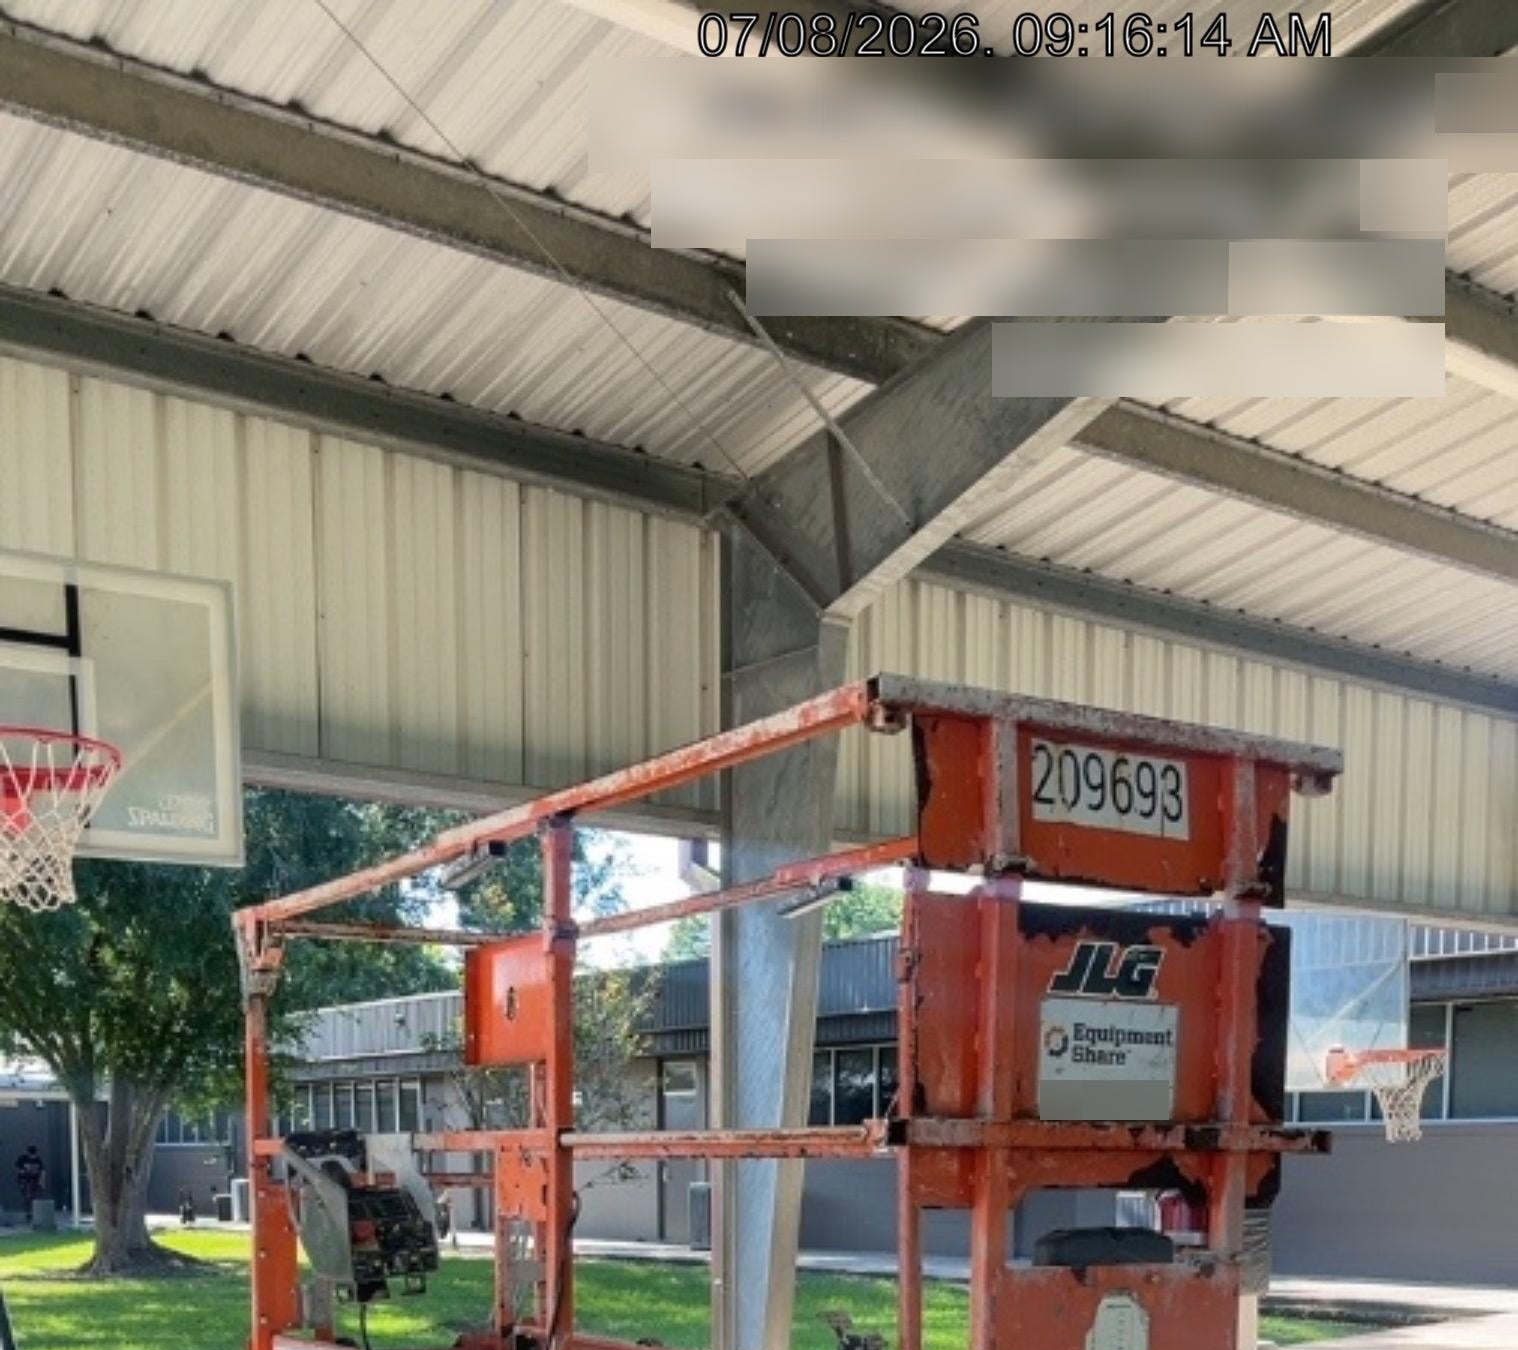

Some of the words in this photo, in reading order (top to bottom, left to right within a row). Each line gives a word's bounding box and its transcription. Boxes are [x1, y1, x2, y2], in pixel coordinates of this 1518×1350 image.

[1033, 744, 1182, 822] 209693
[1047, 941, 1166, 999] JLG
[1072, 1044, 1126, 1066] Share
[1073, 1022, 1173, 1047] Equipment
